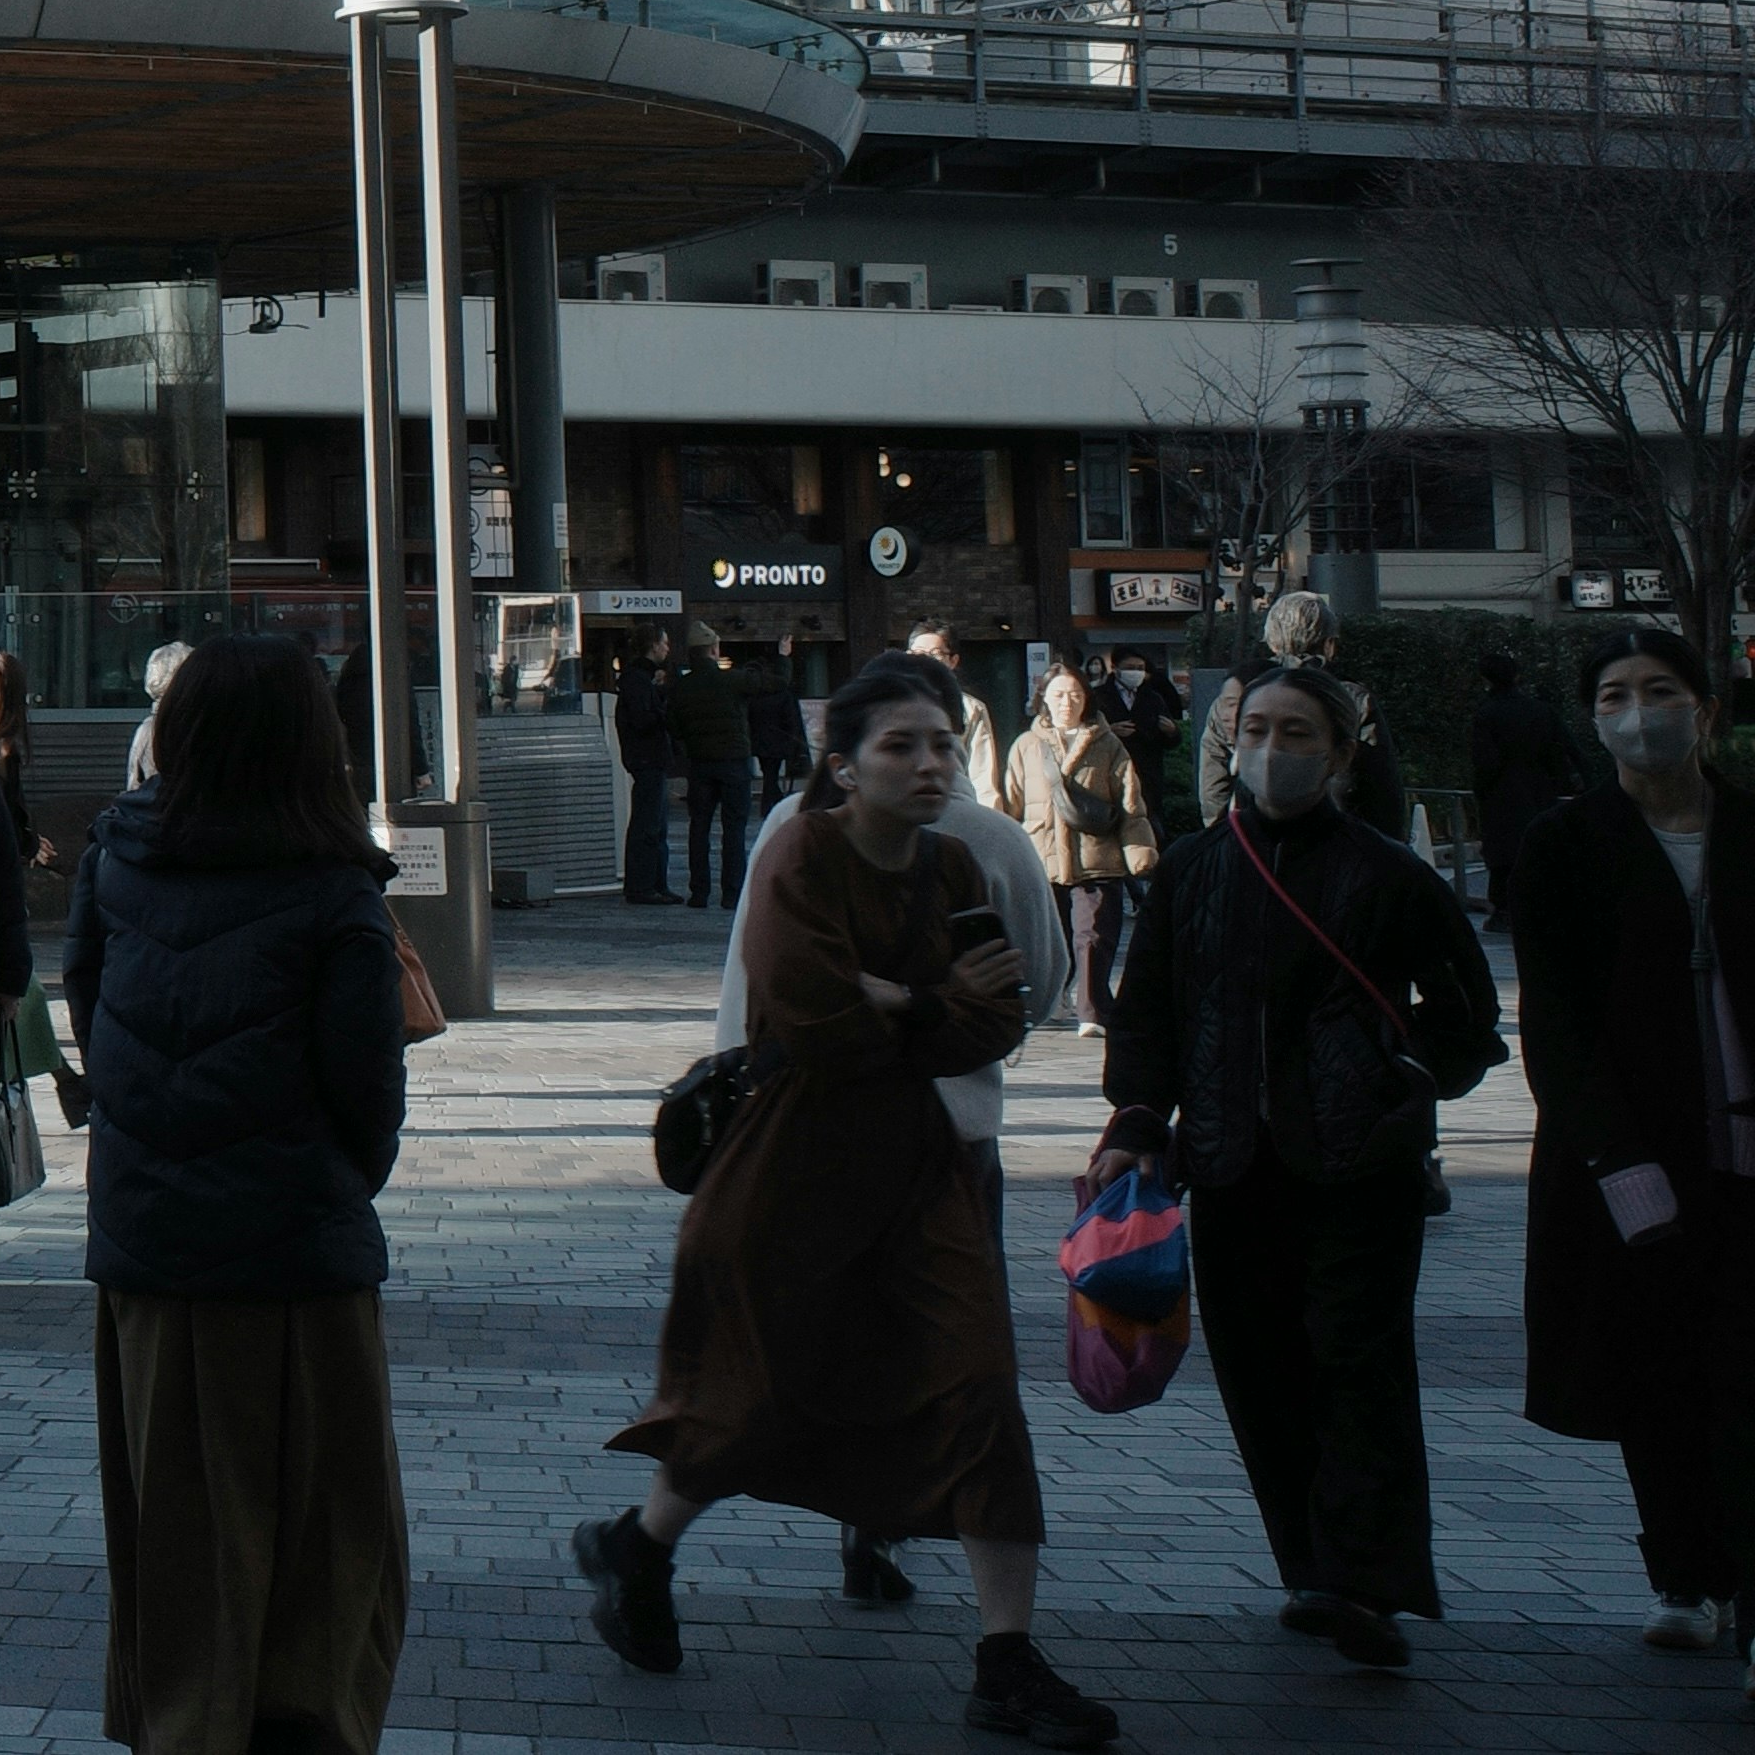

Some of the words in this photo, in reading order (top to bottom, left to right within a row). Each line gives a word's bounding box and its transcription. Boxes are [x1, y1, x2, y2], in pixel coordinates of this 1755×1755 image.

[1163, 233, 1178, 256] 5
[739, 563, 827, 586] PRONTO
[1116, 581, 1139, 601] そば
[626, 596, 672, 609] PRONTO
